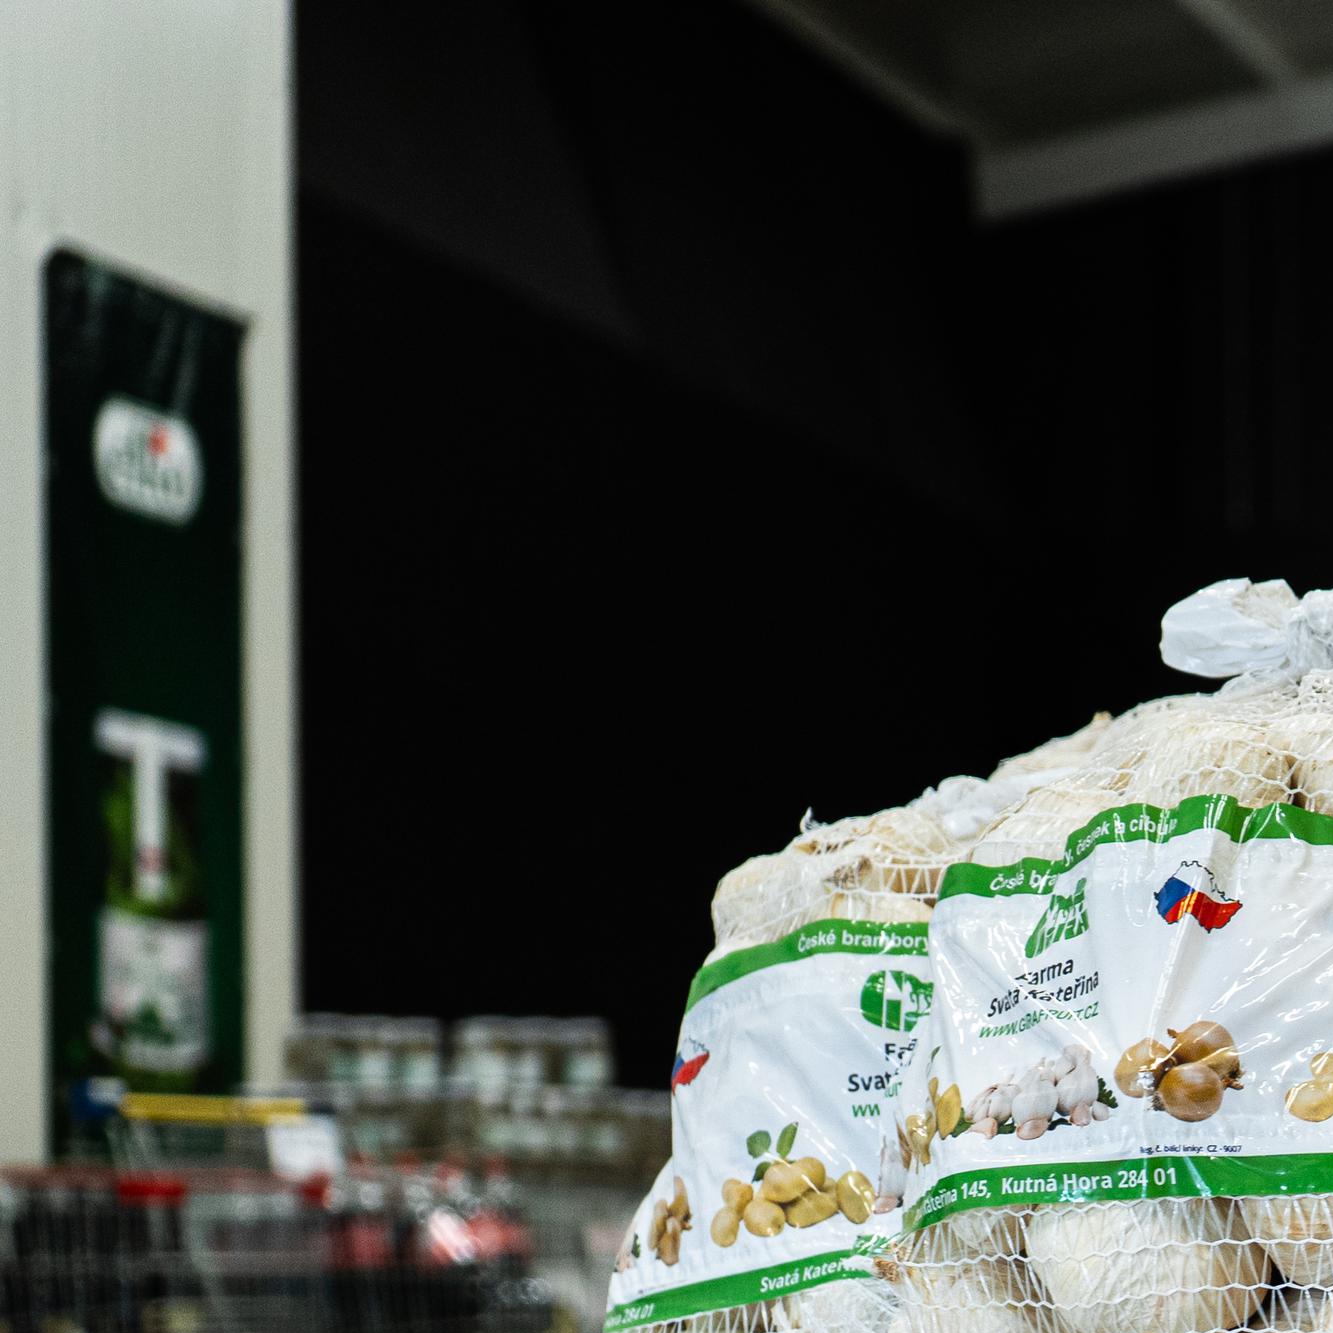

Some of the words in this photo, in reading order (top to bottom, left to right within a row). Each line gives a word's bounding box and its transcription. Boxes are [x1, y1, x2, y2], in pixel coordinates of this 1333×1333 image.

[961, 1180, 991, 1199] 145,
[1001, 1174, 1057, 1195] Kutná
[1062, 1173, 1112, 1191] Hora
[1118, 1170, 1148, 1188] 284
[1154, 1168, 1177, 1185] 01
[760, 1268, 799, 1293] Svatá
